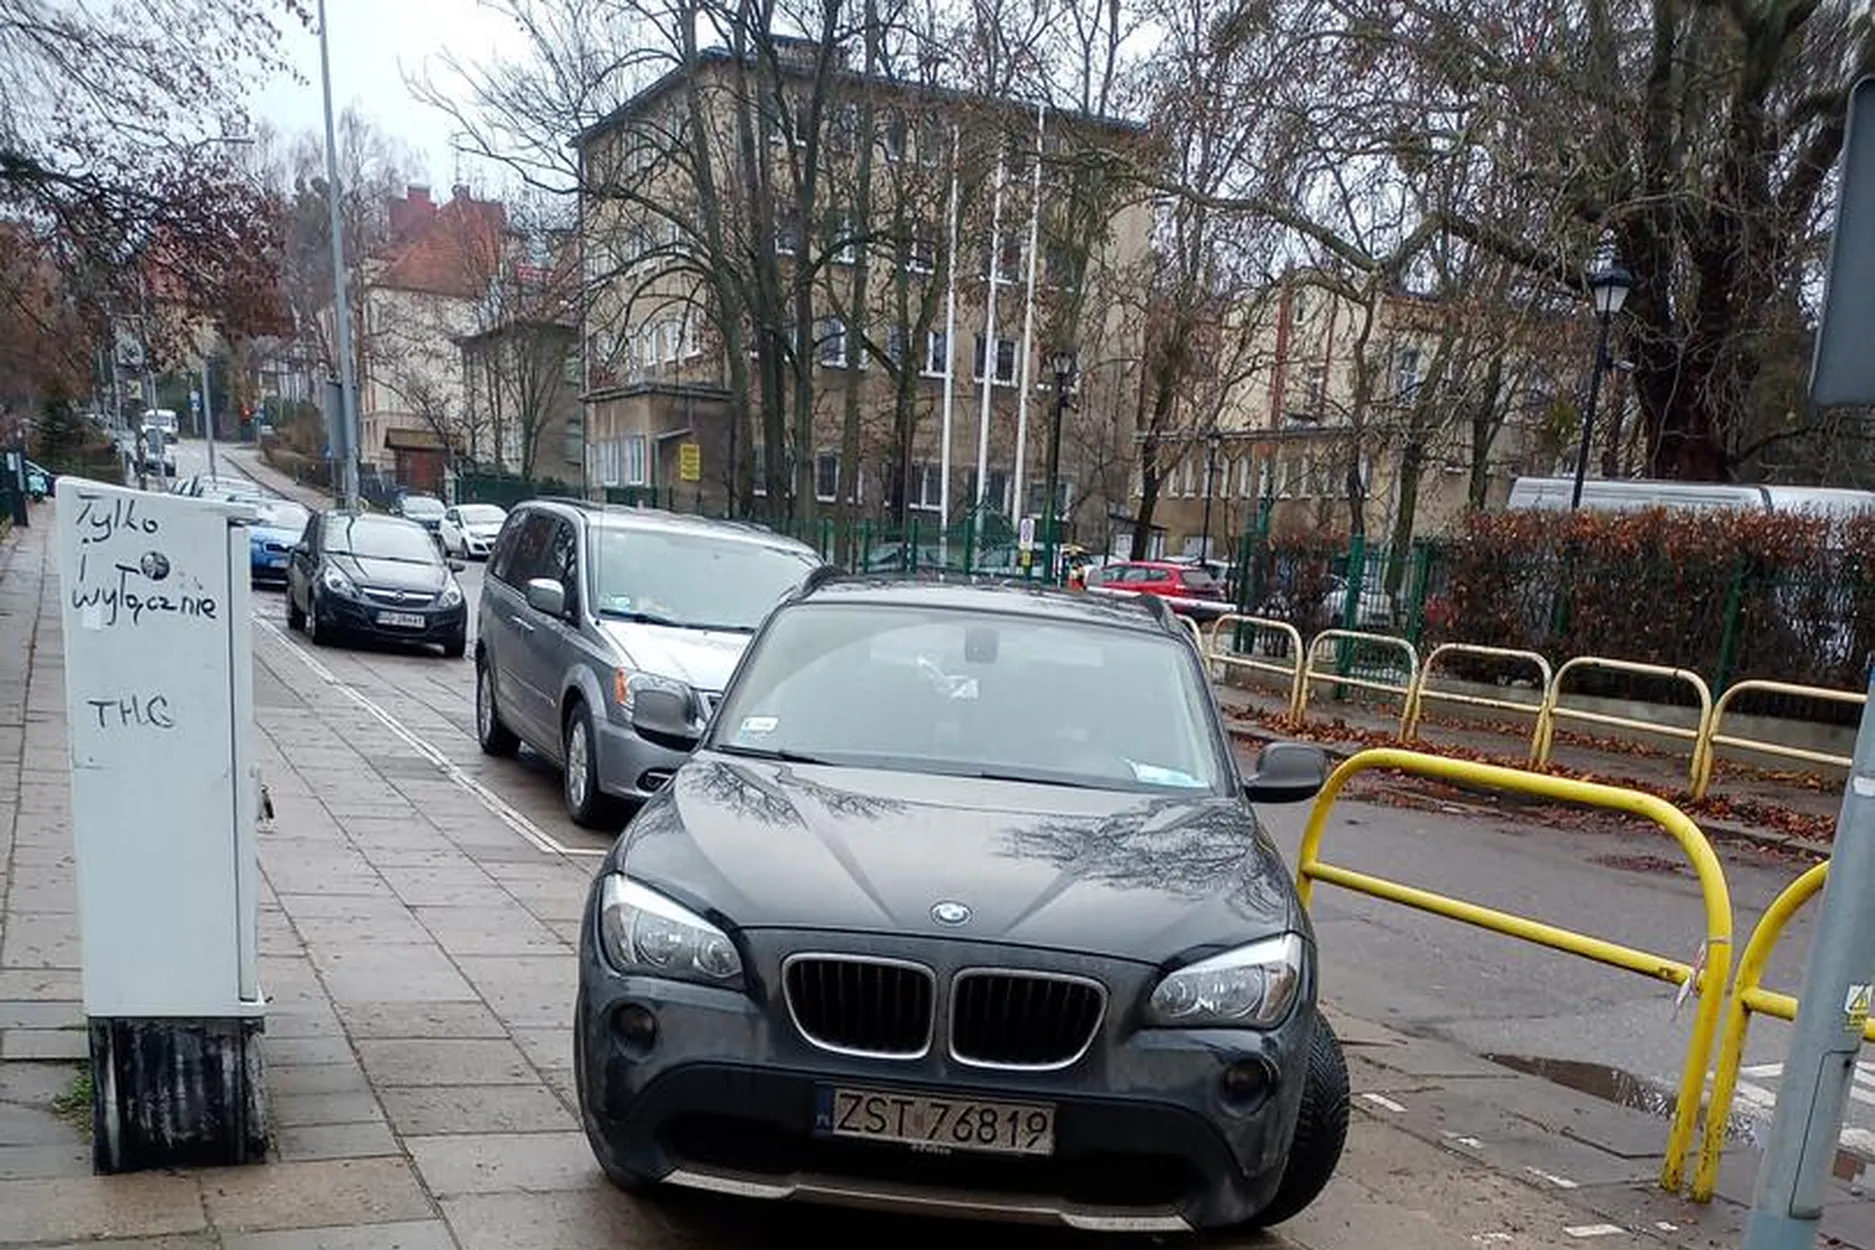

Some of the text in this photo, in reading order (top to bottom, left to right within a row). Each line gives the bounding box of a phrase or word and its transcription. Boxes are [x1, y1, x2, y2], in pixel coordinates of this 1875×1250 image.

[76, 494, 159, 542] Tylko
[79, 536, 90, 583] i
[836, 1093, 1048, 1148] ZST 76819
